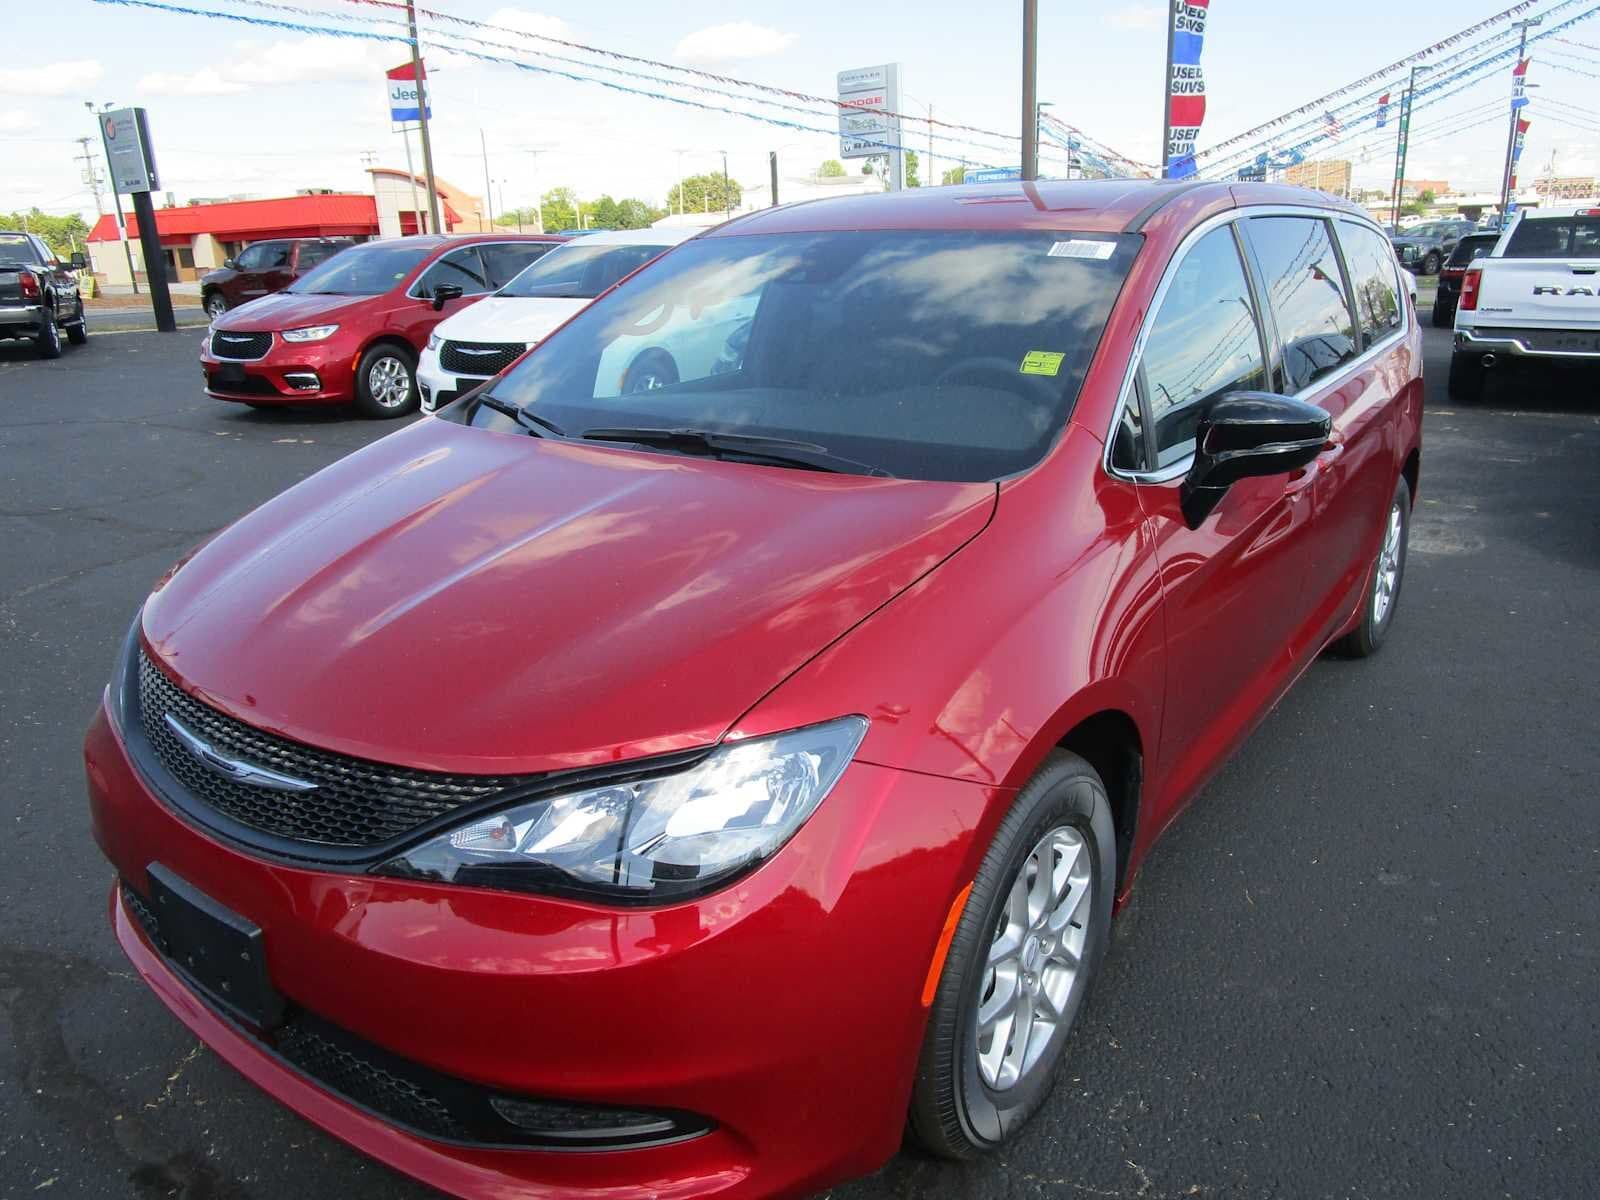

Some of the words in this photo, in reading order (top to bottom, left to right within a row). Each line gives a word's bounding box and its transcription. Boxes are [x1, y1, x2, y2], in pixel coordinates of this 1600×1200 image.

[1173, 66, 1203, 79] USED
[1172, 80, 1205, 93] SUVS
[392, 87, 427, 100] Jee
[1533, 286, 1600, 296] RA
